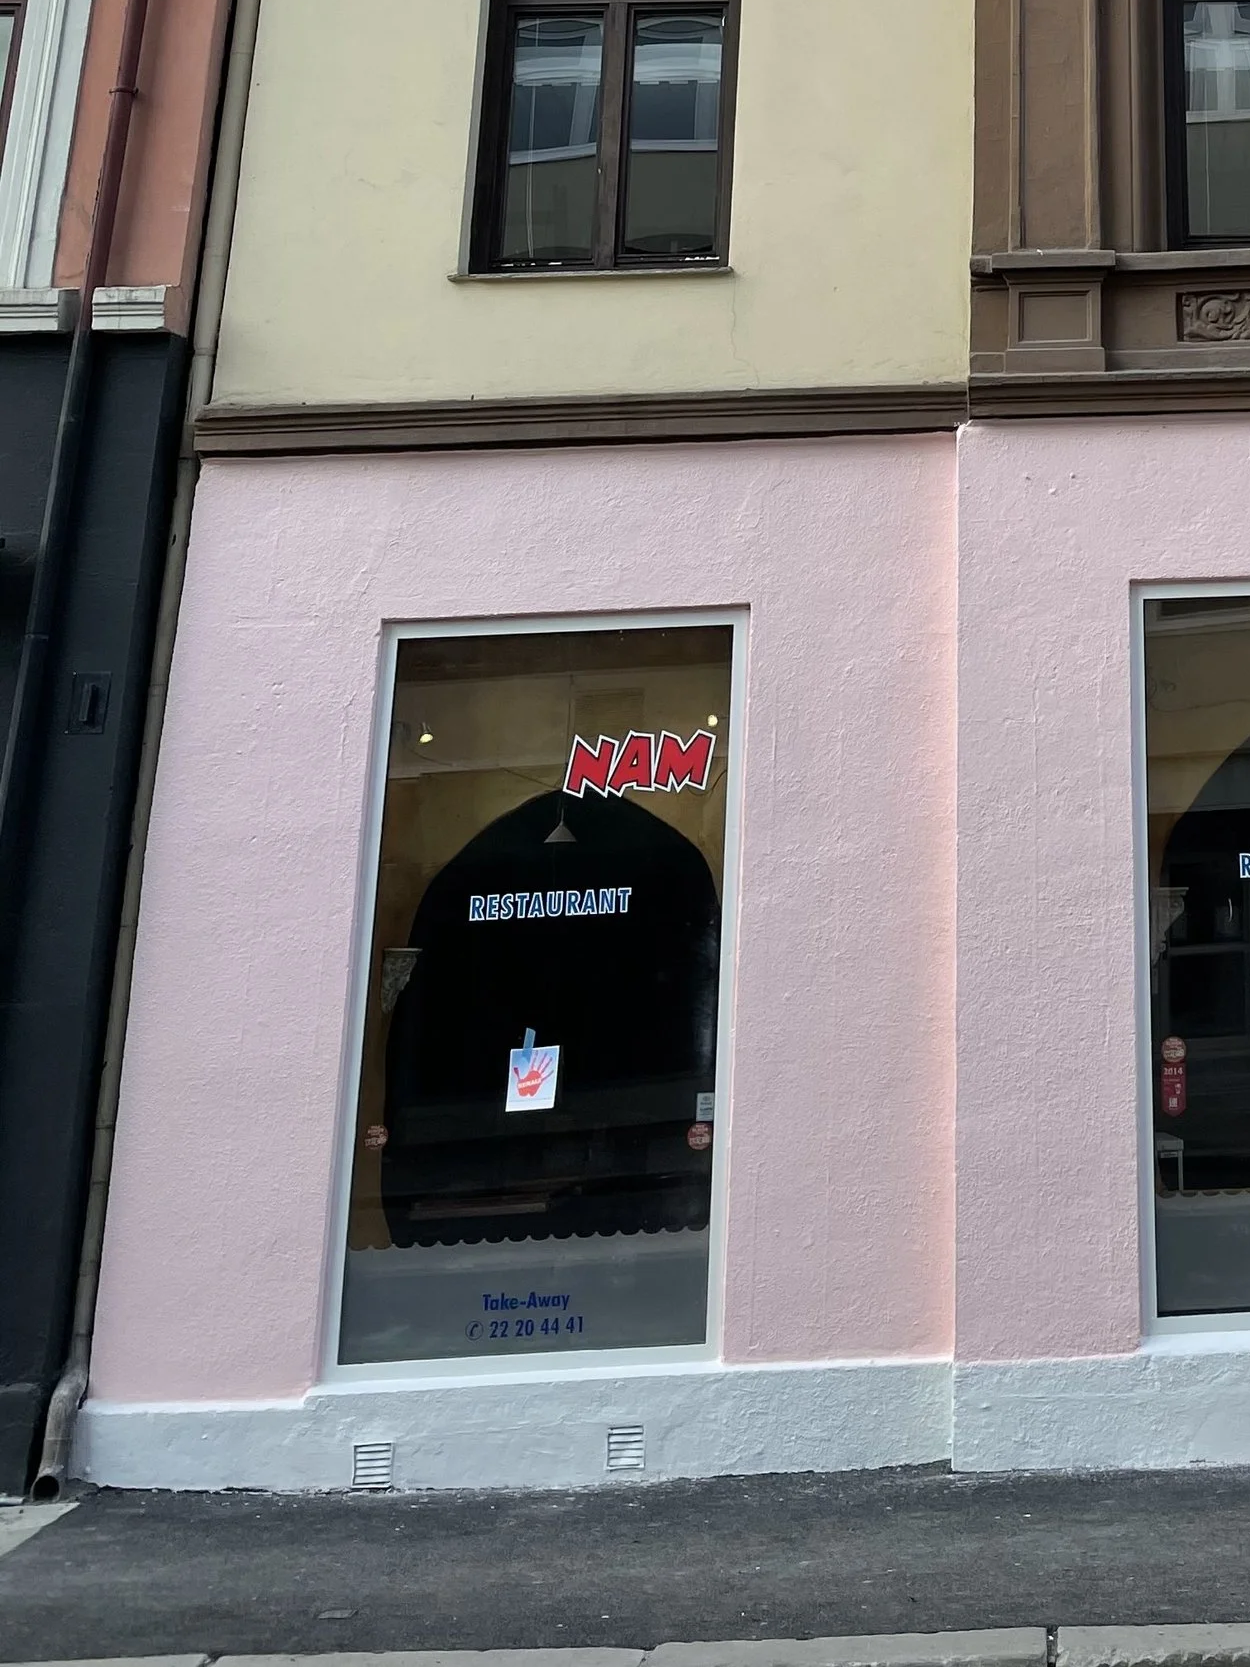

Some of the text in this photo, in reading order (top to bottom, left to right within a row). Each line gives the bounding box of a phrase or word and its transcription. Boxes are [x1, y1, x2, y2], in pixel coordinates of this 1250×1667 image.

[562, 729, 717, 799] NAM
[469, 887, 632, 922] RESTAURANT
[482, 1291, 570, 1311] Take-Away
[489, 1316, 583, 1338] 22 20 44 41
